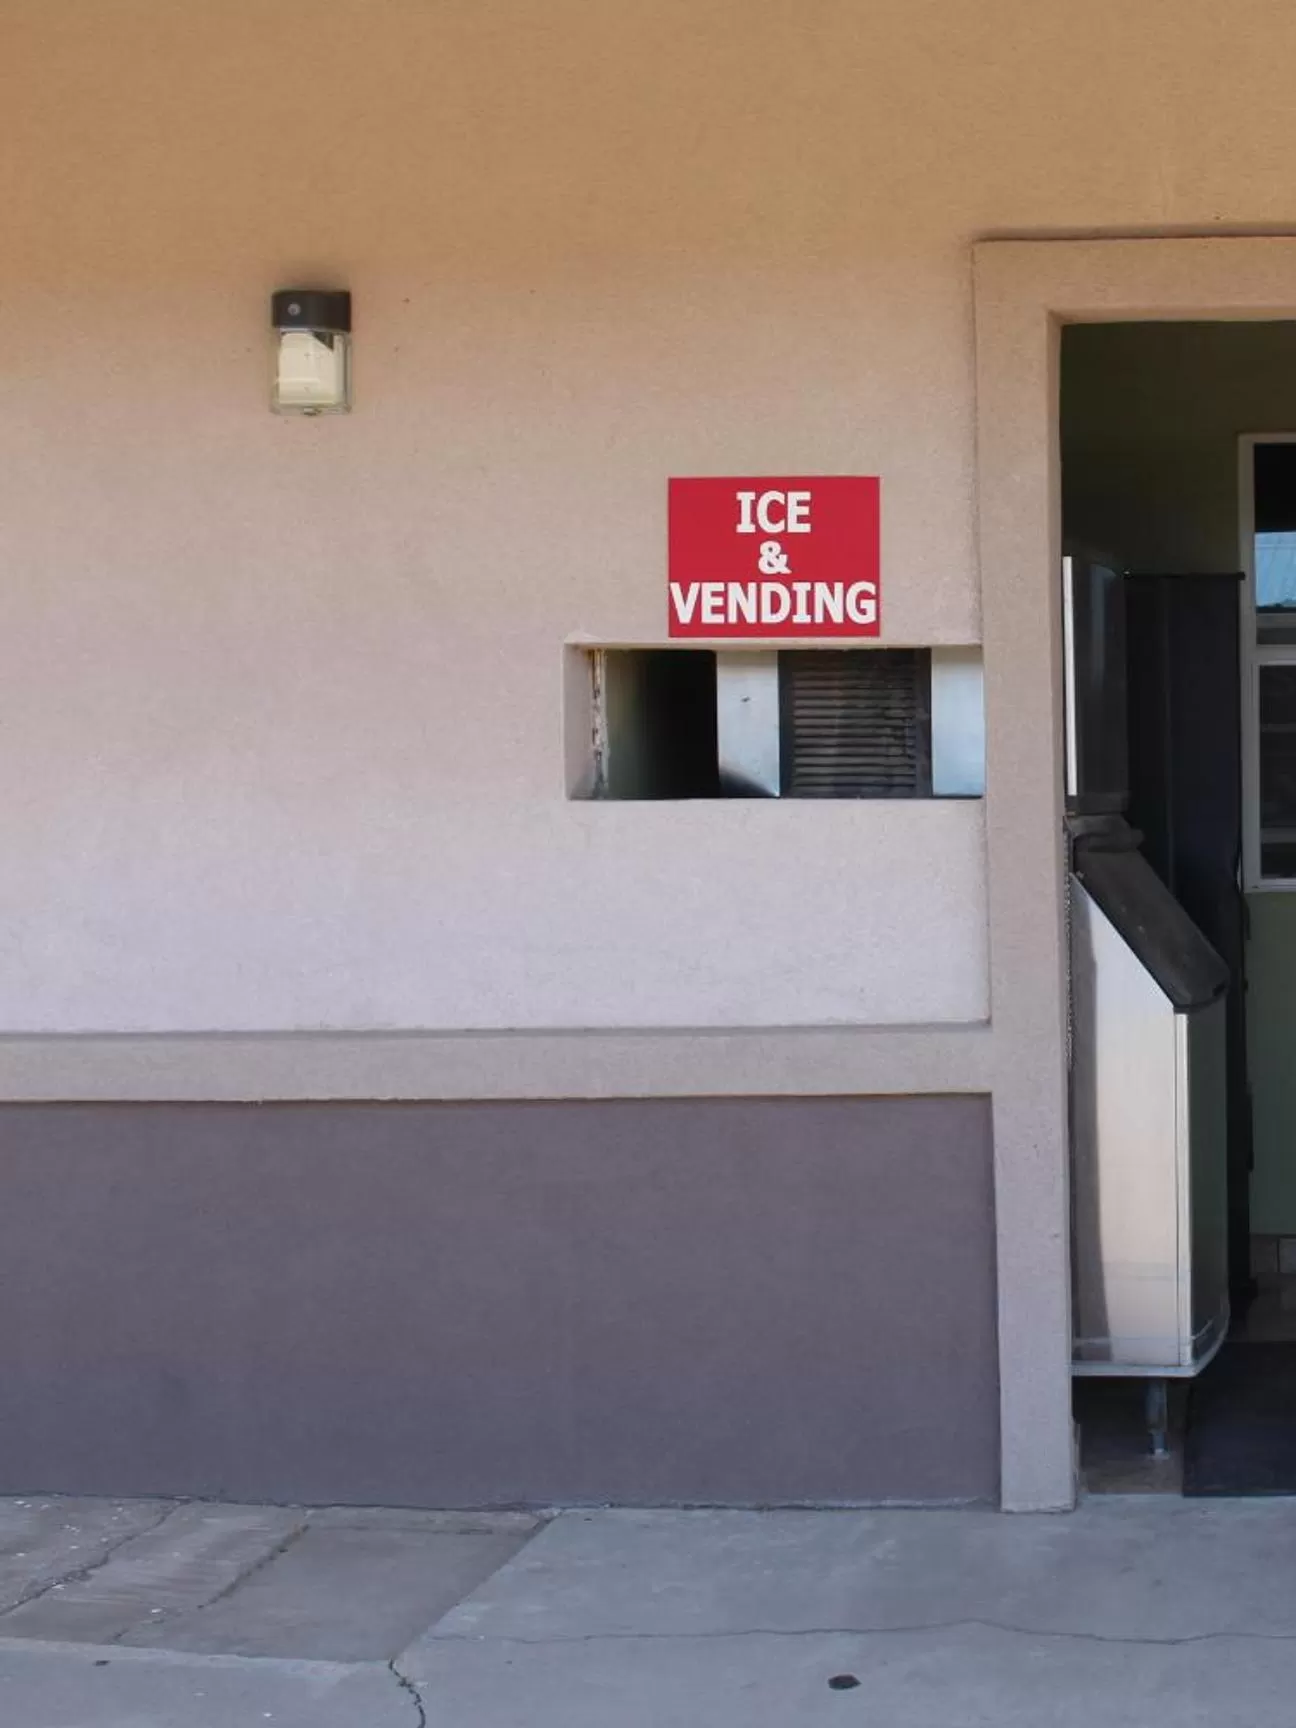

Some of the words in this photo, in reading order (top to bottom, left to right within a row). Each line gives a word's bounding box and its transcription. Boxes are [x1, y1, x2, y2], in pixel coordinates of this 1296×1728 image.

[736, 491, 811, 533] ICE
[758, 541, 792, 574] &
[670, 581, 877, 624] VENDING
